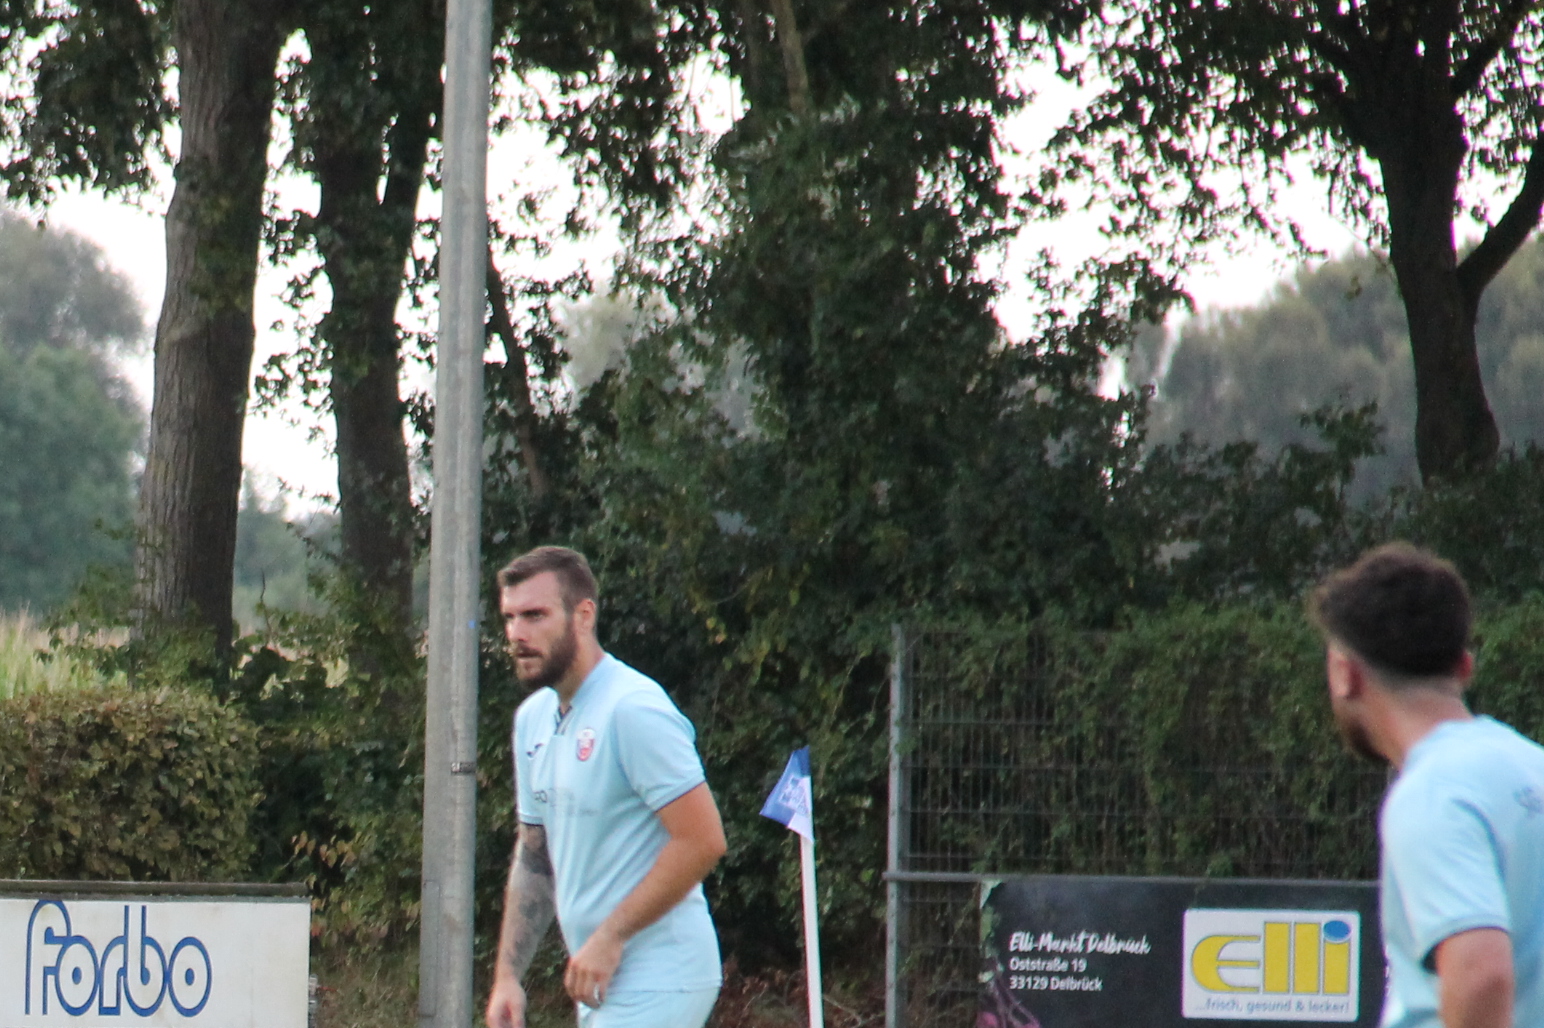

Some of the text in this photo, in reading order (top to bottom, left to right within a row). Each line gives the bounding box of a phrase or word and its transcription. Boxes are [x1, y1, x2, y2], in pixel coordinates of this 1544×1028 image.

[1010, 930, 1152, 954] Elli-Markt Delbrück
[25, 899, 212, 1017] forbo
[1010, 956, 1087, 973] Oststraße 19
[1010, 975, 1103, 991] 33129 Delbrück
